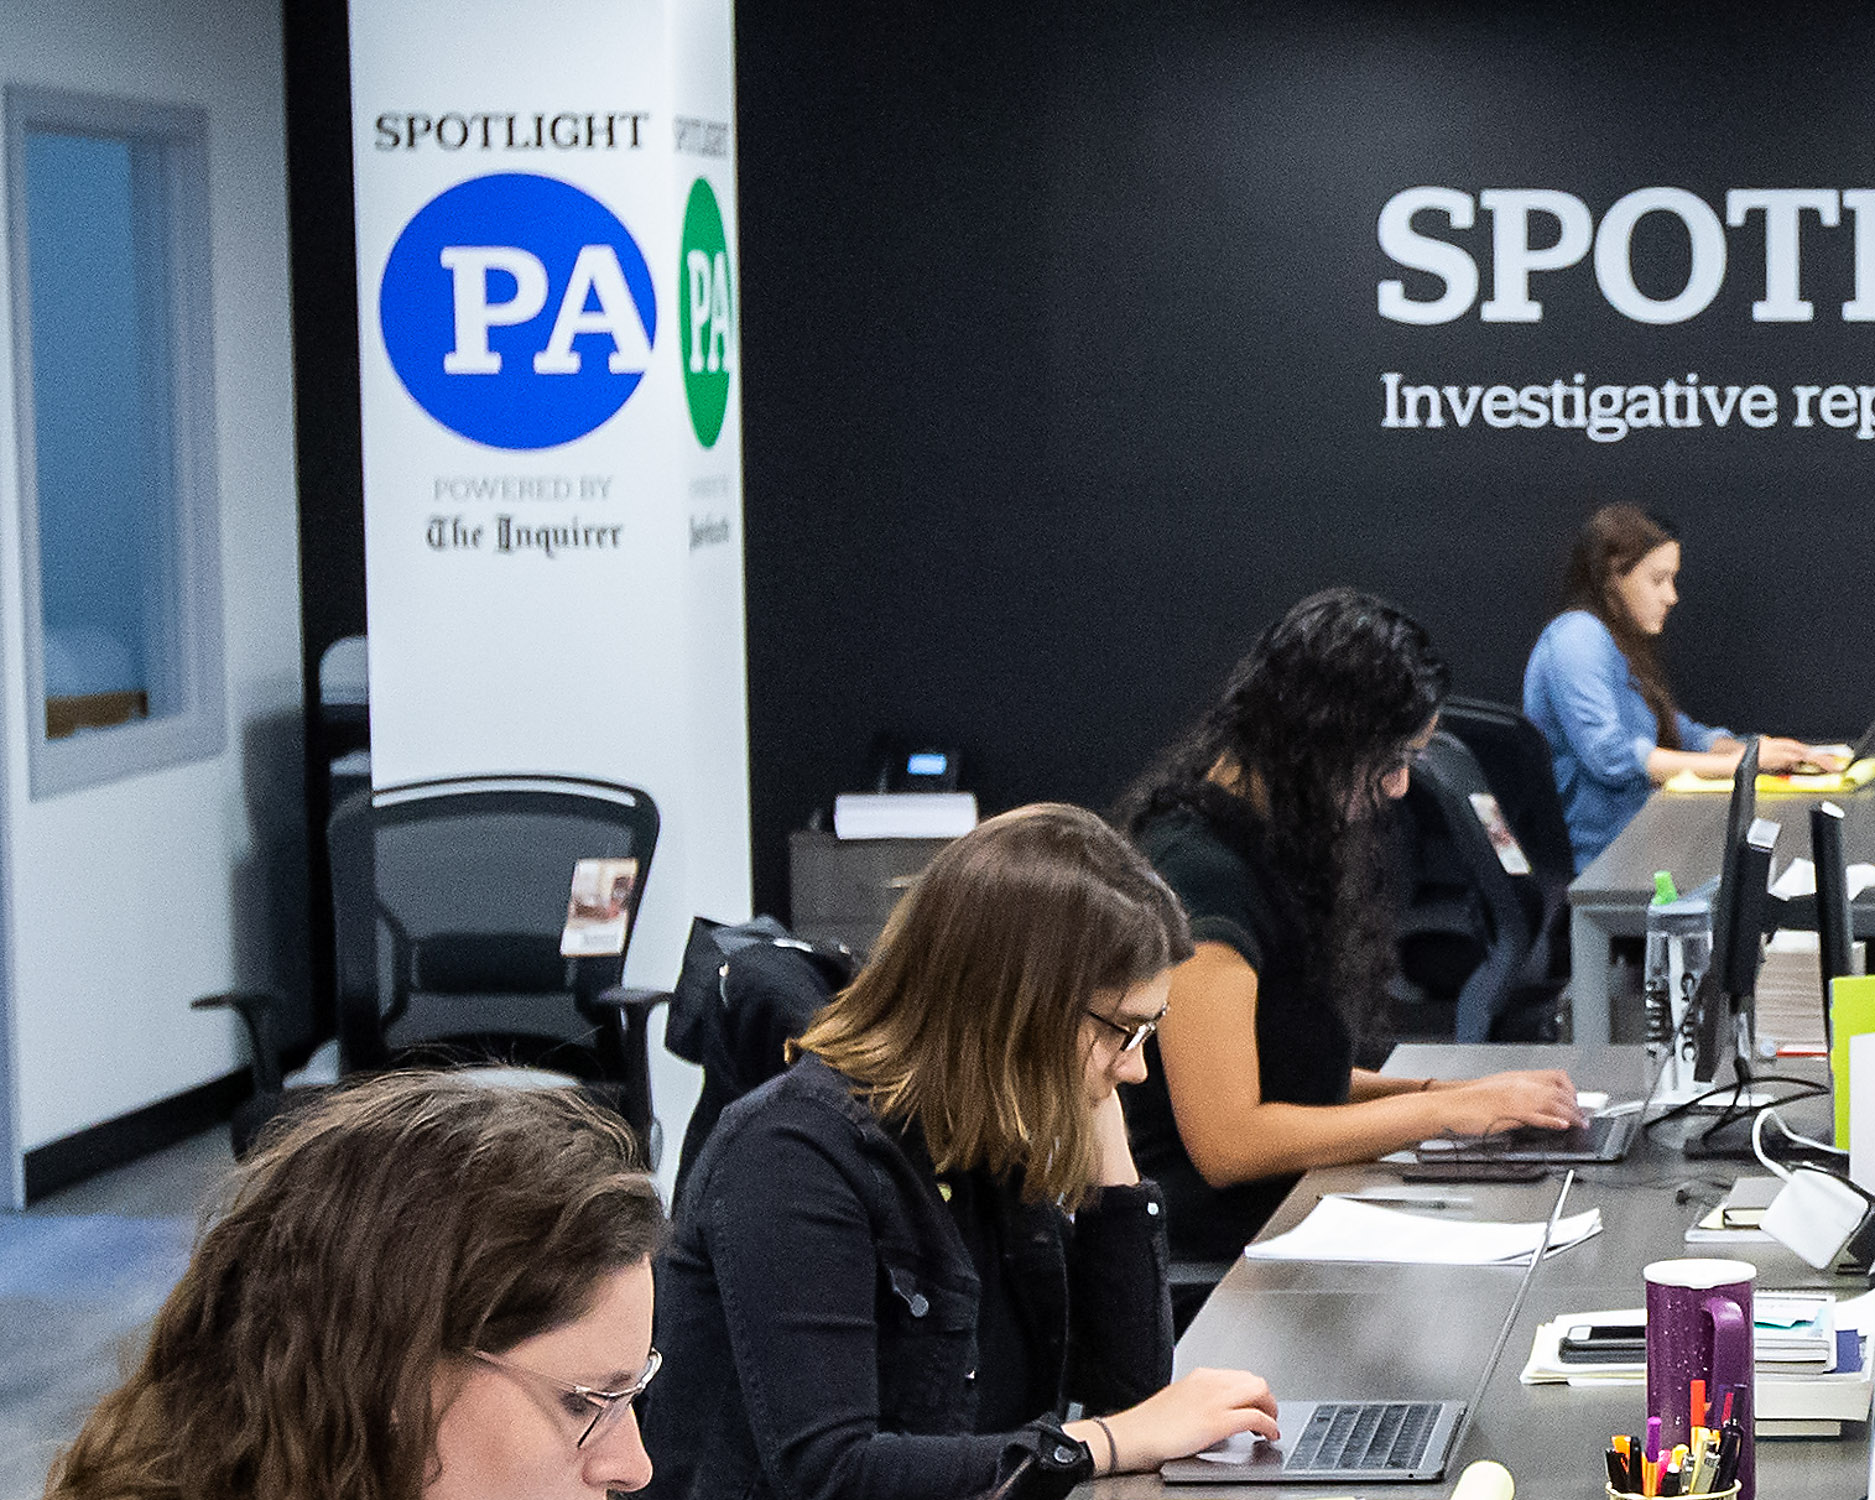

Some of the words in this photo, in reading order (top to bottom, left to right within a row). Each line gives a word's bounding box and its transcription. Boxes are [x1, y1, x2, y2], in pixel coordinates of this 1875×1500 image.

[374, 112, 649, 152] SPOTLIGHT
[440, 244, 653, 375] PA
[687, 249, 732, 373] PA
[1380, 373, 1778, 443] Investigative
[433, 476, 571, 500] POWERED
[579, 475, 613, 499] BY
[427, 515, 481, 549] The
[496, 513, 623, 559] Inquirer
